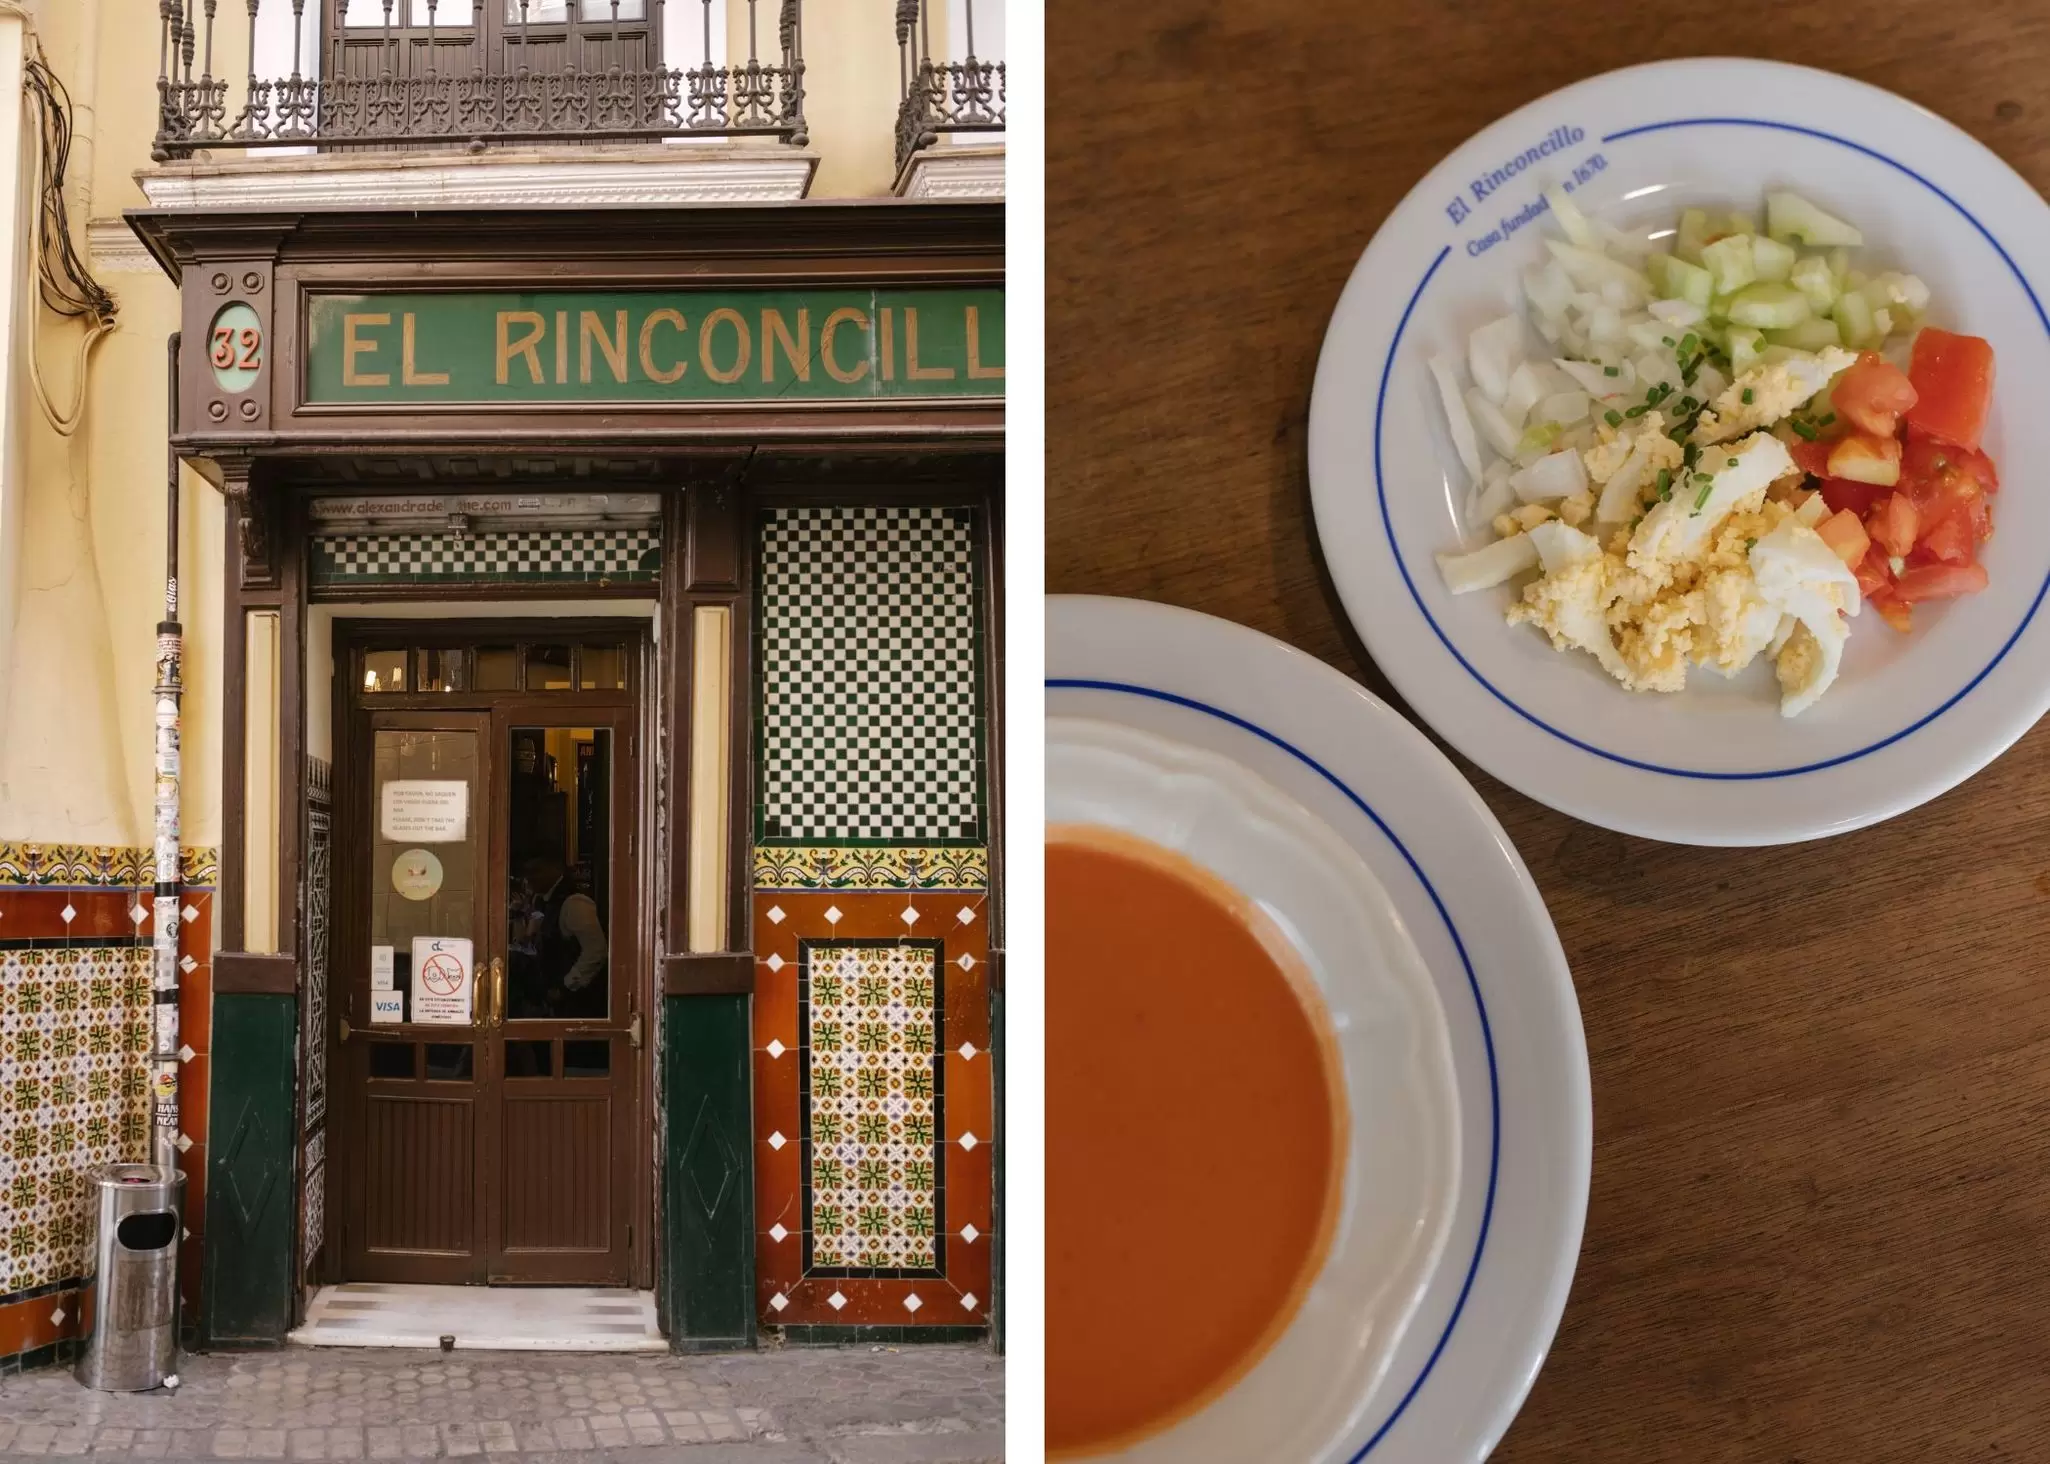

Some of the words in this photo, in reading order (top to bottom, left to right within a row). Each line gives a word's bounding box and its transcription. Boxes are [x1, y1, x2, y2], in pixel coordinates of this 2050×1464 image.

[1445, 196, 1472, 227] El
[1469, 125, 1585, 203] Rinconcillo
[1466, 229, 1502, 257] Casa
[1499, 192, 1551, 241] fundad
[210, 325, 261, 370] 32
[342, 312, 451, 386] EL
[375, 1002, 400, 1012] VISA
